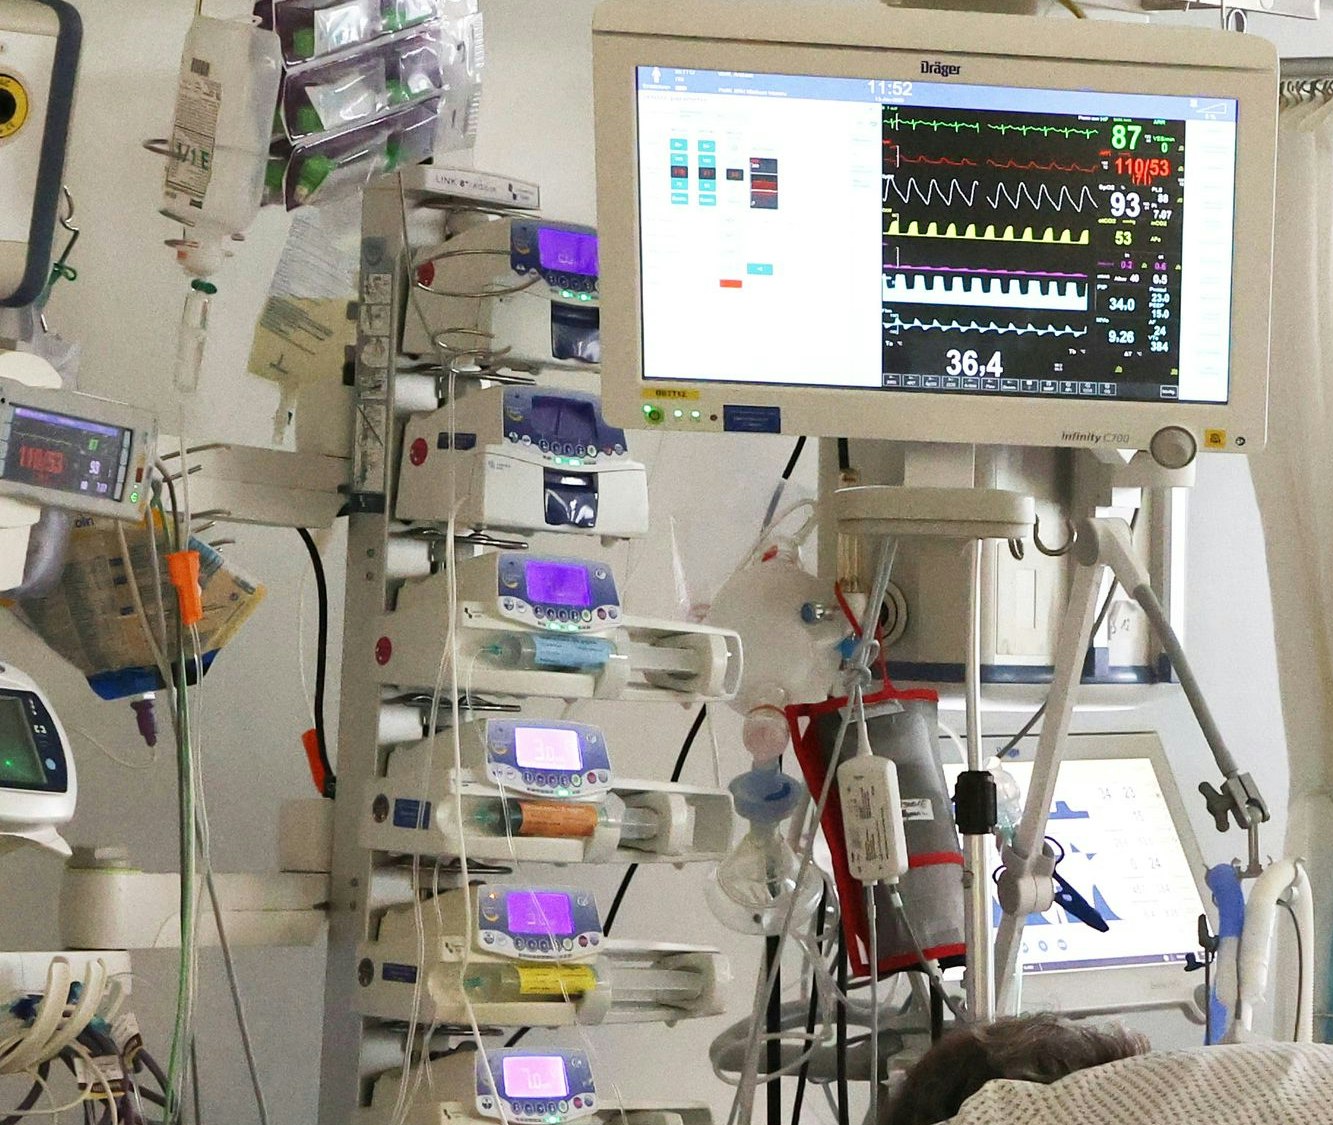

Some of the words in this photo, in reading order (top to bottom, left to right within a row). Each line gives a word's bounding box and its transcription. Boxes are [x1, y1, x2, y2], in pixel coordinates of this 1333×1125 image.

[920, 60, 961, 77] Dräger
[867, 79, 913, 97] 11:52
[1112, 124, 1142, 150] 87
[1161, 142, 1168, 153] 0
[1115, 157, 1170, 176] 110/53
[435, 176, 457, 186] LINK
[1110, 191, 1141, 218] 93
[1115, 230, 1132, 245] 53
[1154, 326, 1167, 336] 24
[1150, 341, 1169, 352] 384
[945, 349, 1004, 378] 36,4
[1061, 431, 1102, 444] Infinity
